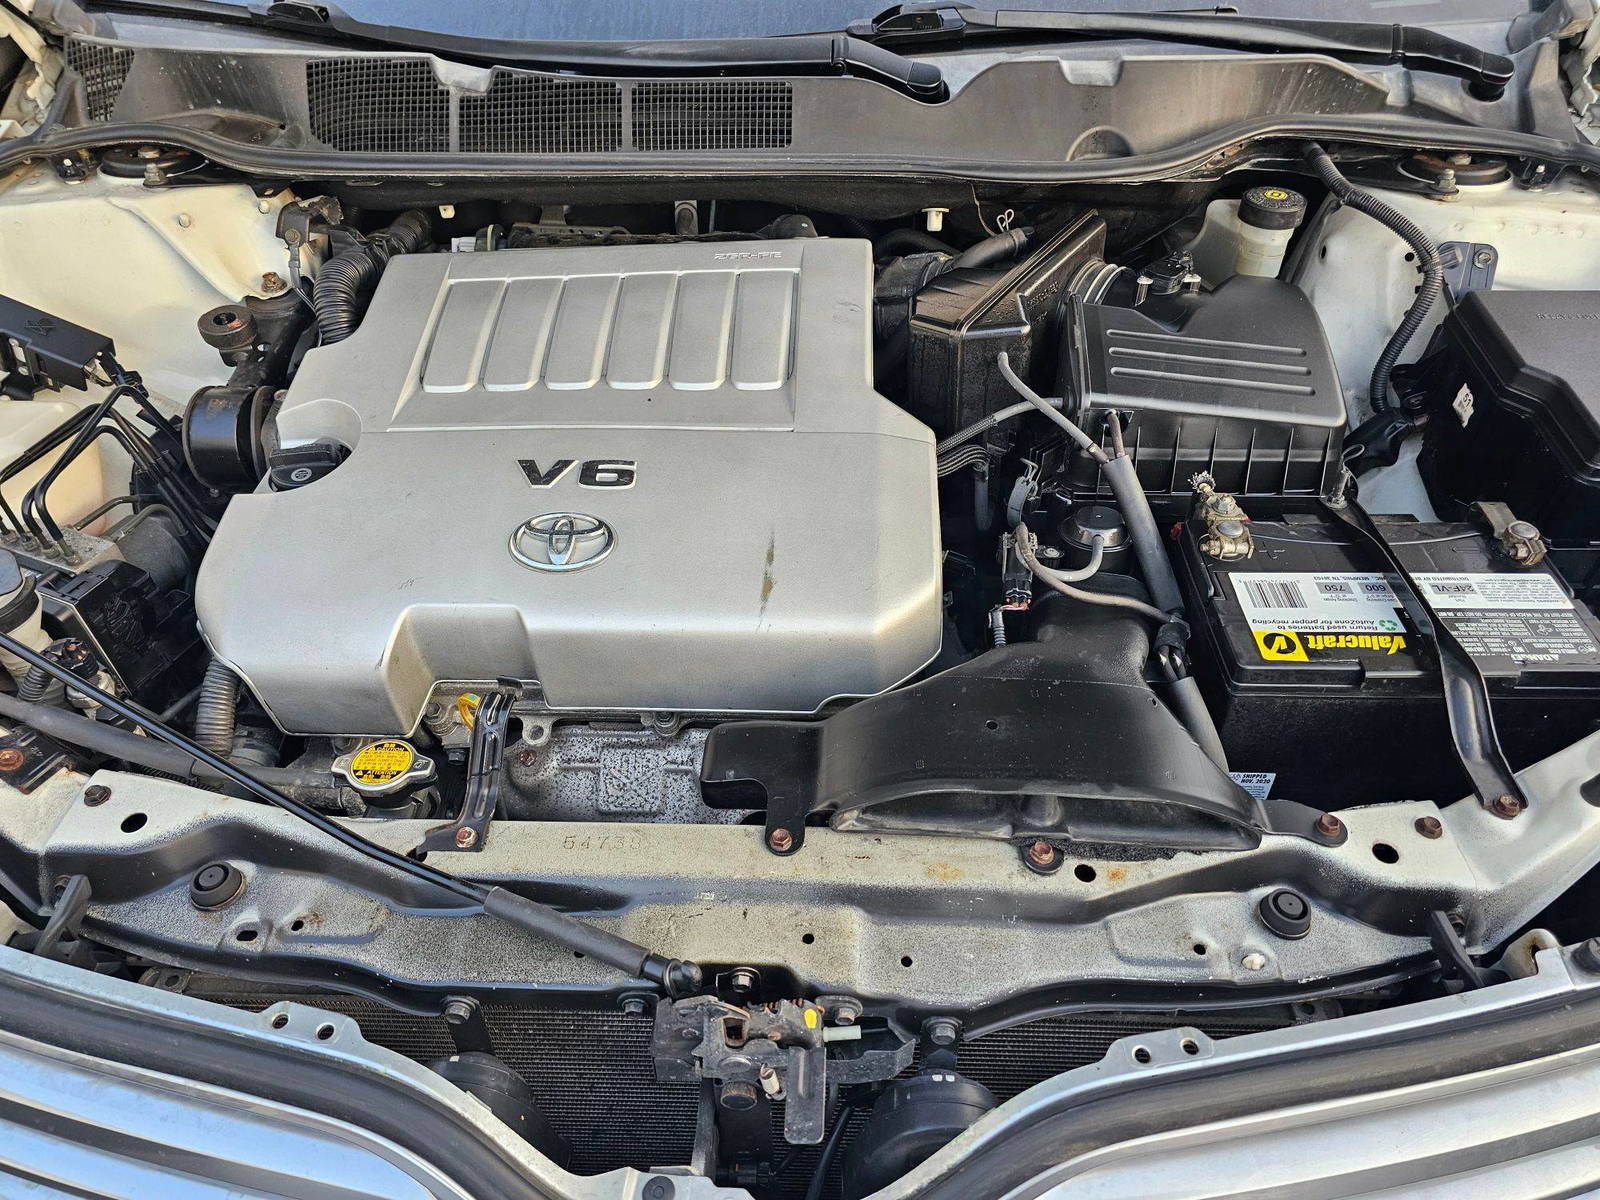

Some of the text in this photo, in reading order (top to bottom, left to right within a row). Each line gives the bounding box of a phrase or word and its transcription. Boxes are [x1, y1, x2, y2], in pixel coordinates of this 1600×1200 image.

[515, 459, 637, 490] V6
[1324, 584, 1346, 592] 750
[1365, 584, 1386, 592] 600
[1308, 634, 1407, 655] Valucraft
